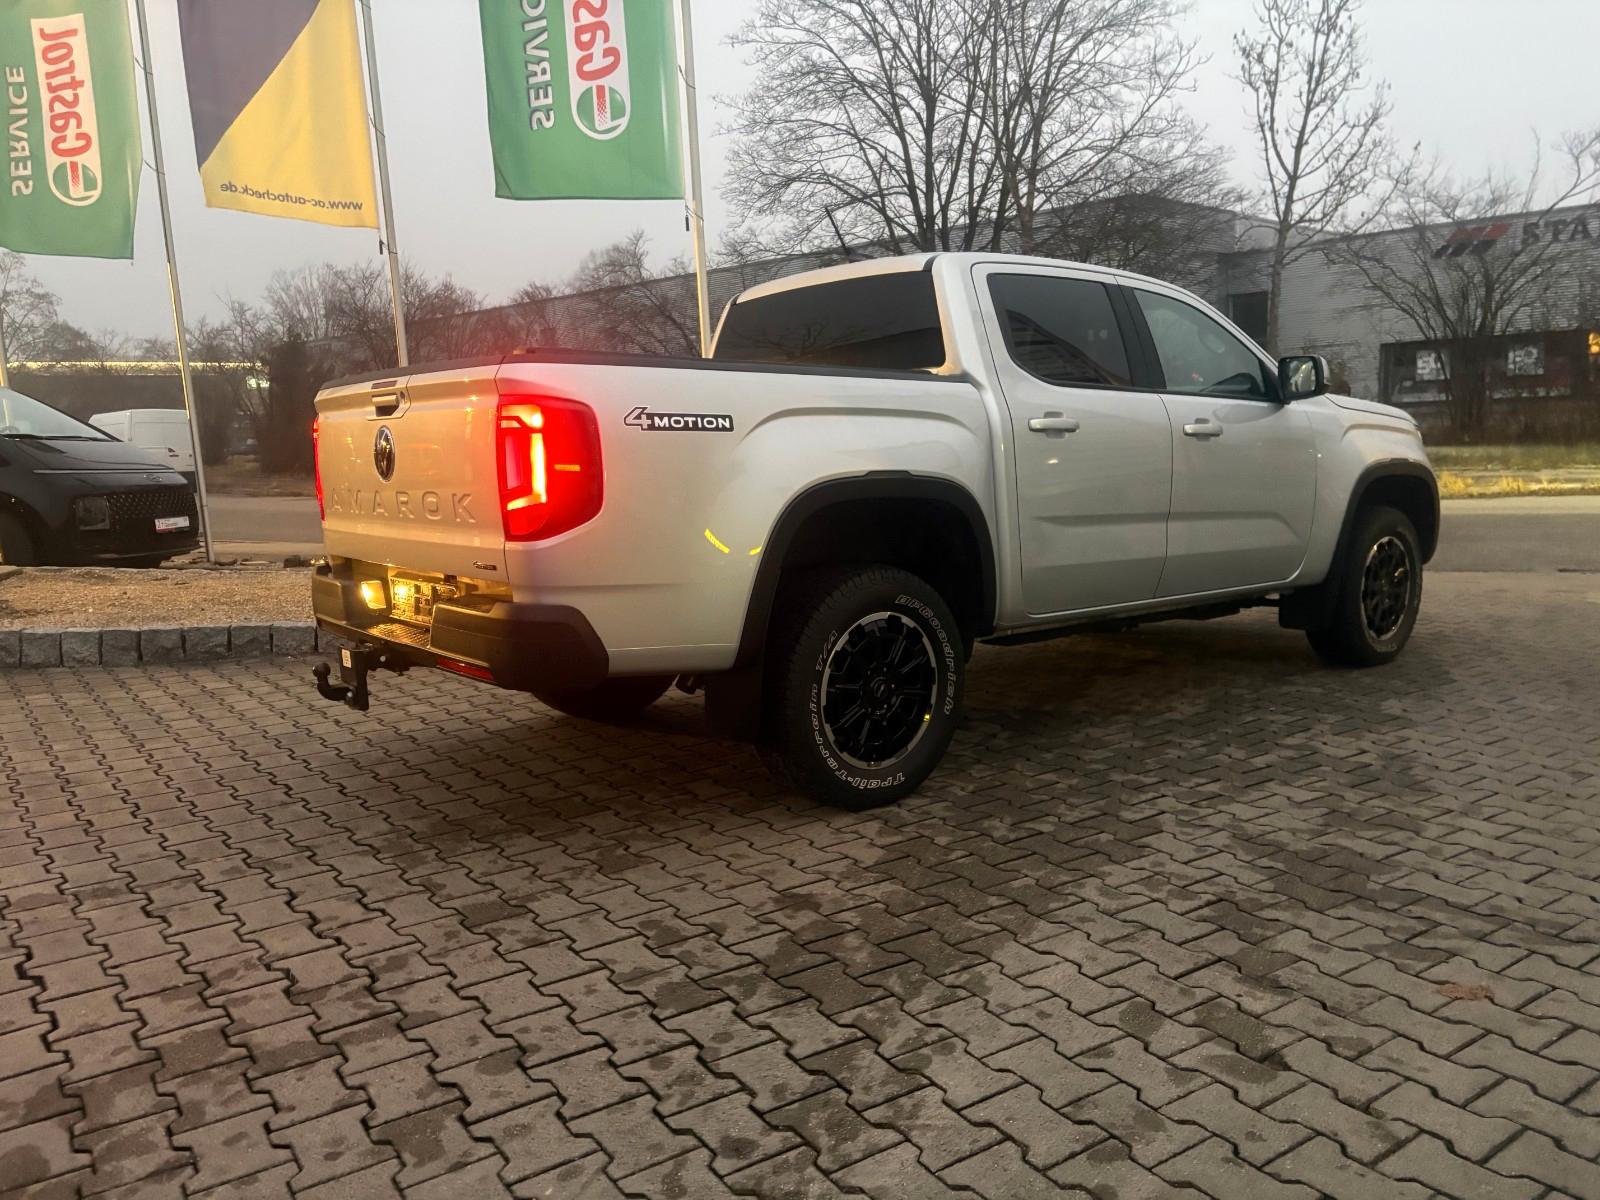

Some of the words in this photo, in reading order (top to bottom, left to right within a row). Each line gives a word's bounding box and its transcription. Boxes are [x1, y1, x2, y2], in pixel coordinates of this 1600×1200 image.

[624, 407, 731, 431] 4MOTION
[330, 488, 476, 523] AMAROK
[895, 594, 957, 715] BFGoodrich
